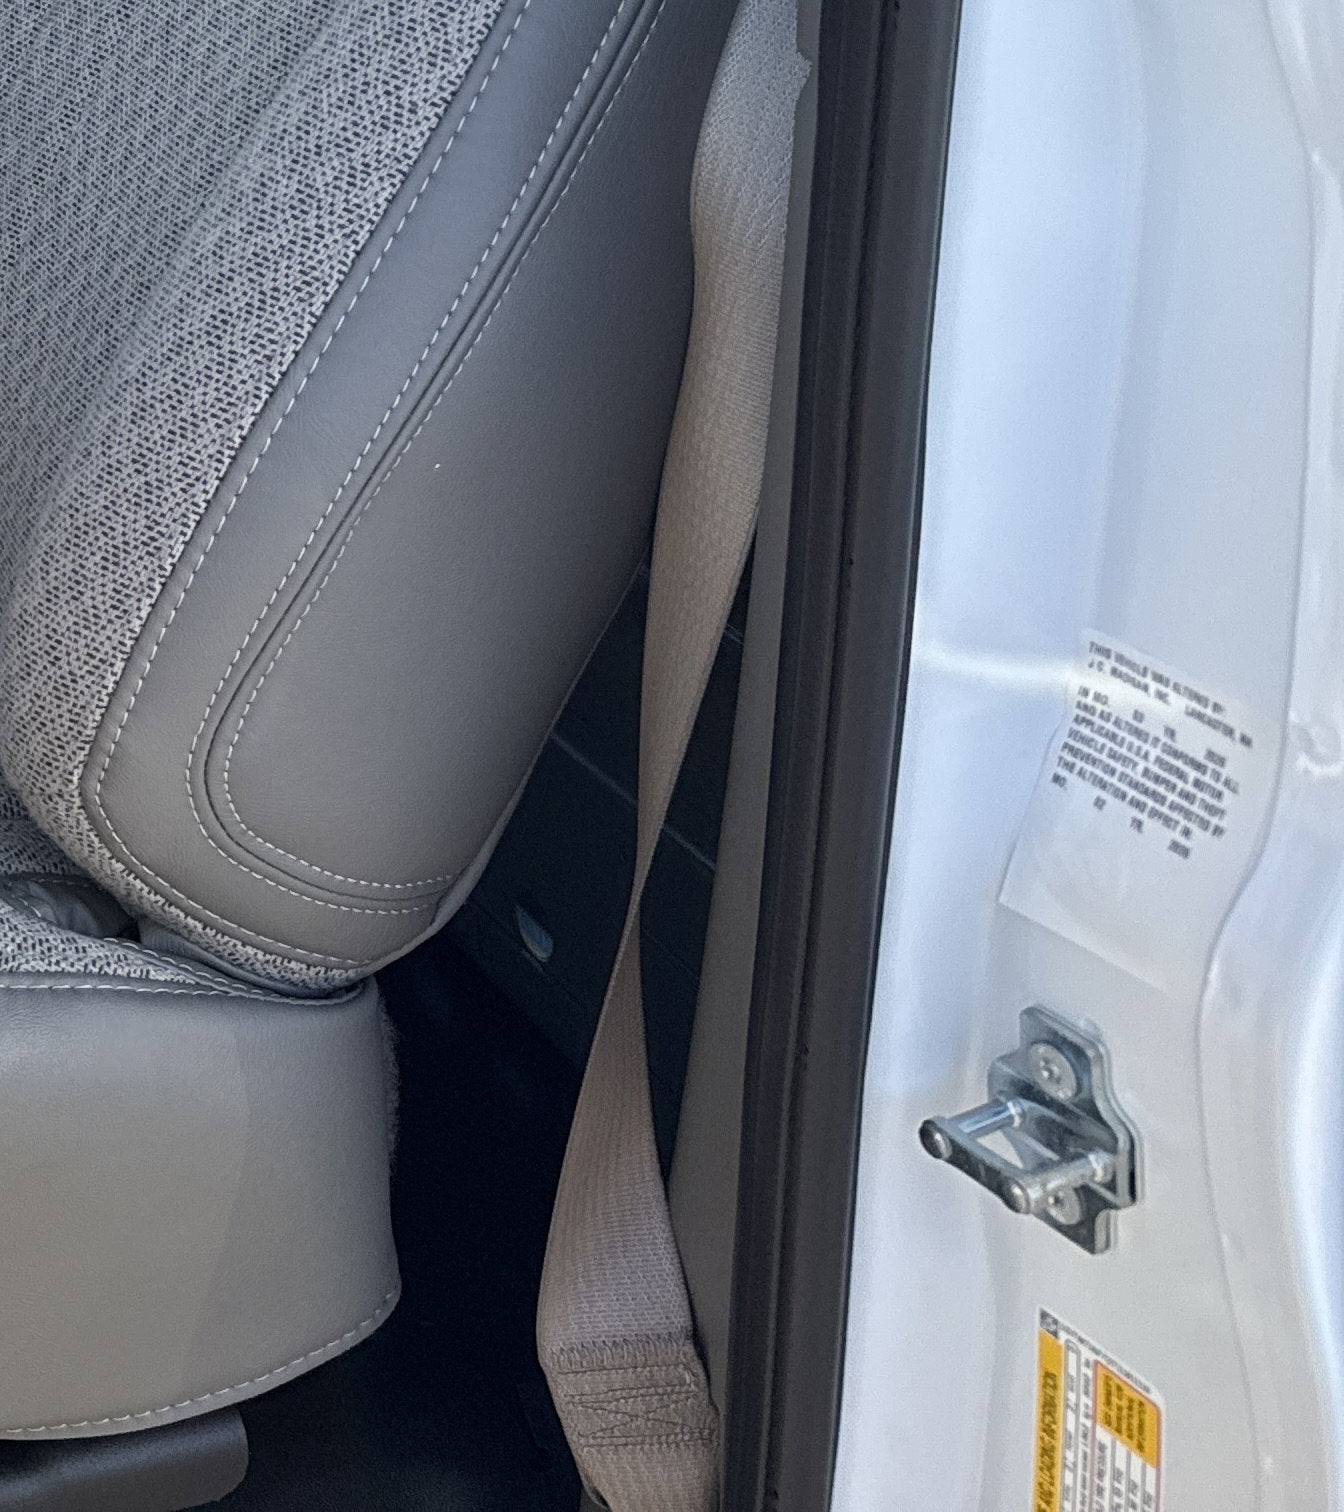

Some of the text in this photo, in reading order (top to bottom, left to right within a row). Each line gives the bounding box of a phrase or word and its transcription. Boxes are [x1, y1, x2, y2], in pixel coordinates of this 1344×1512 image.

[1089, 641, 1112, 660] THIS
[1114, 651, 1149, 678] VEHICLE
[1072, 713, 1127, 749] APPLICABLE
[1075, 700, 1097, 717] AND
[1098, 709, 1112, 723] AS
[1112, 716, 1150, 744] ALTERED
[1057, 755, 1076, 774] THE
[1076, 766, 1128, 802] ALTERATION
[1128, 795, 1148, 814] AND
[1062, 741, 1116, 778] PREVENTION
[1117, 771, 1168, 807] STANDARDS
[1067, 727, 1107, 755] VEHICLE
[1141, 766, 1178, 794] BUMPER
[1178, 787, 1197, 805] AND
